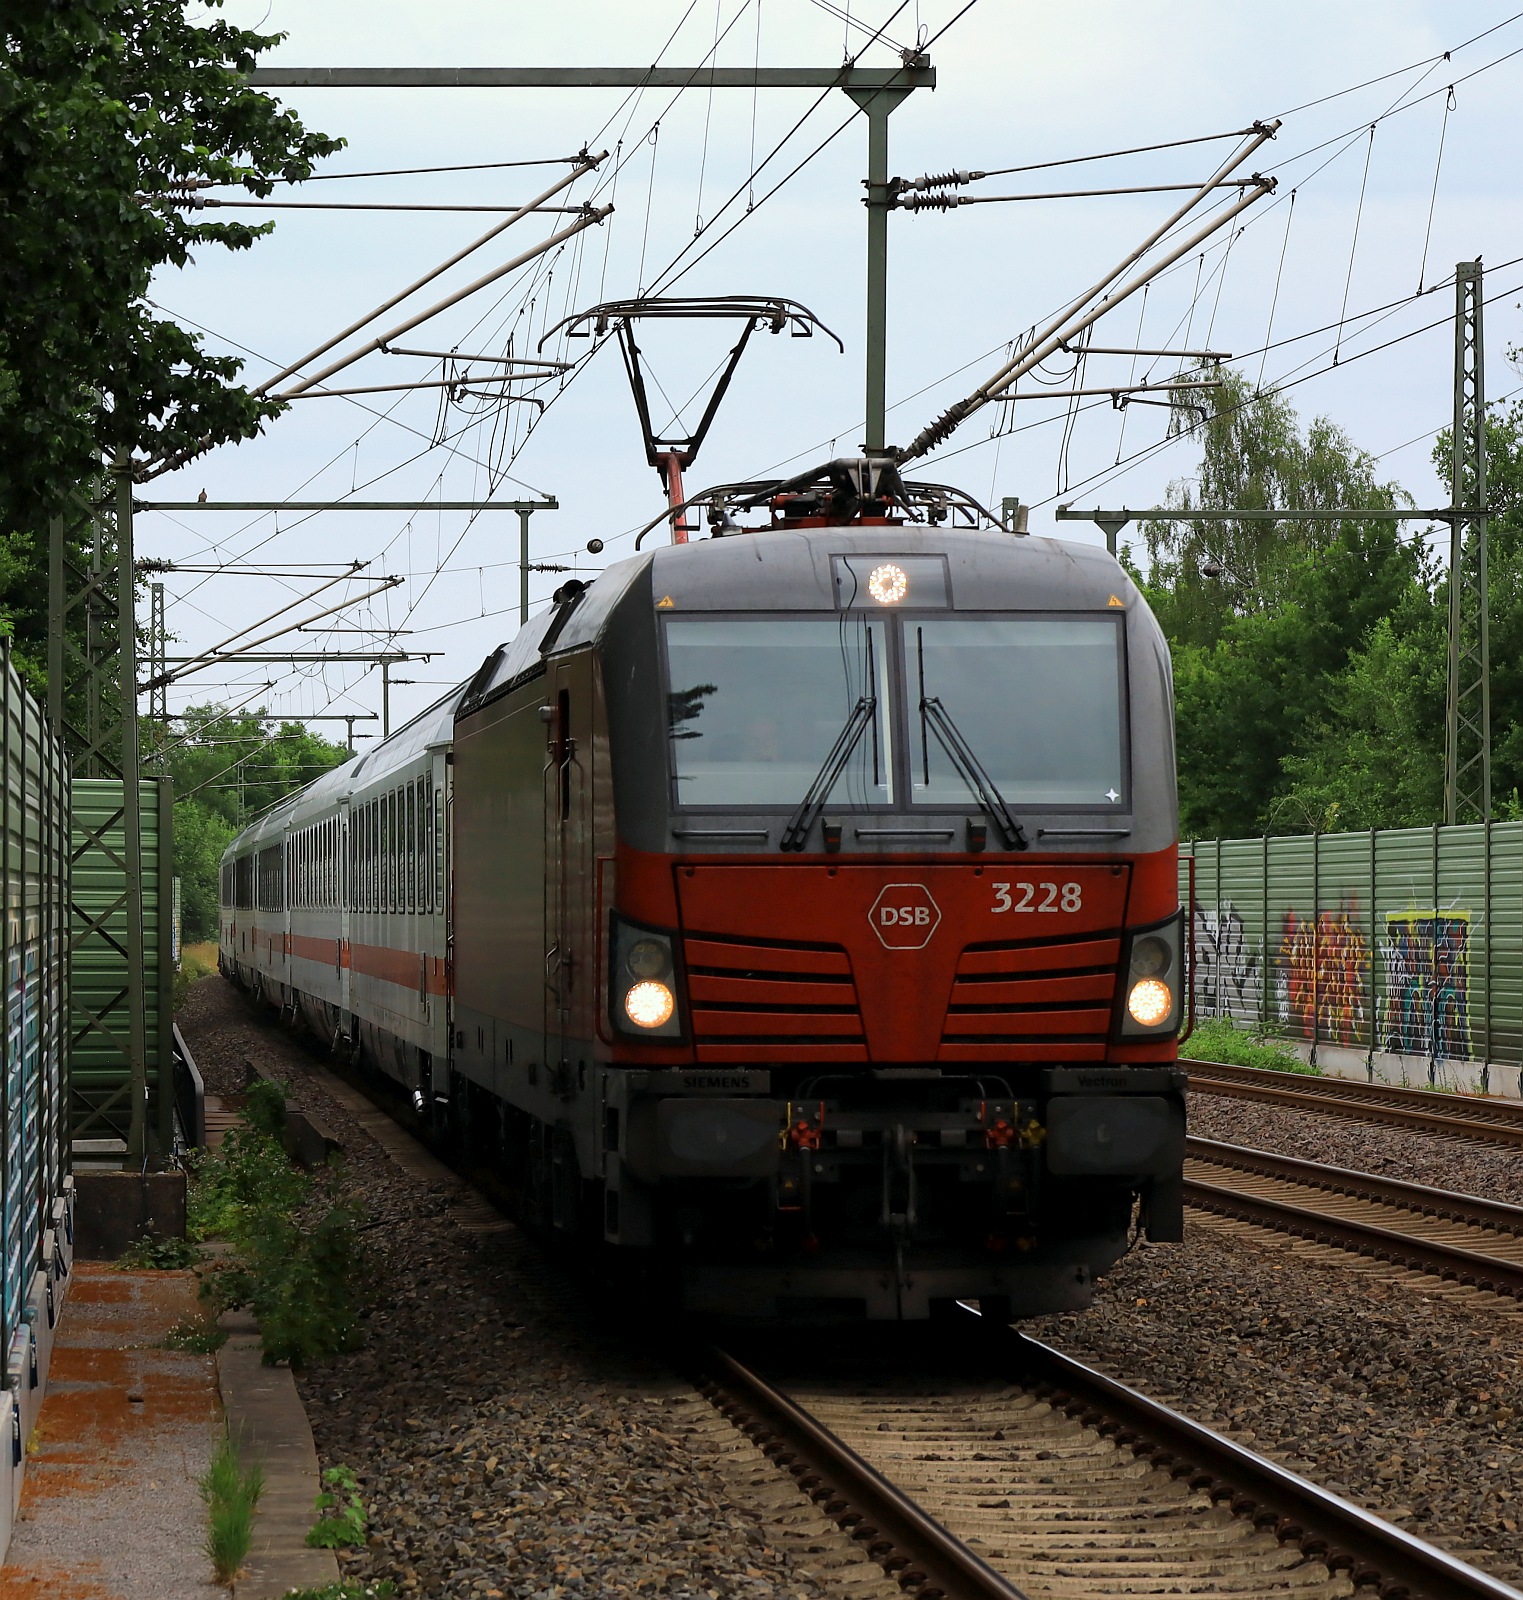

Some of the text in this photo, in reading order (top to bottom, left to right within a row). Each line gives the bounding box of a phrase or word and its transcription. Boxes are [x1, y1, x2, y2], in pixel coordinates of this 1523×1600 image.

[990, 883, 1082, 913] 3228
[880, 906, 930, 926] DSB
[683, 1076, 750, 1089] SIEMENS
[1077, 1075, 1127, 1088] Vectron
